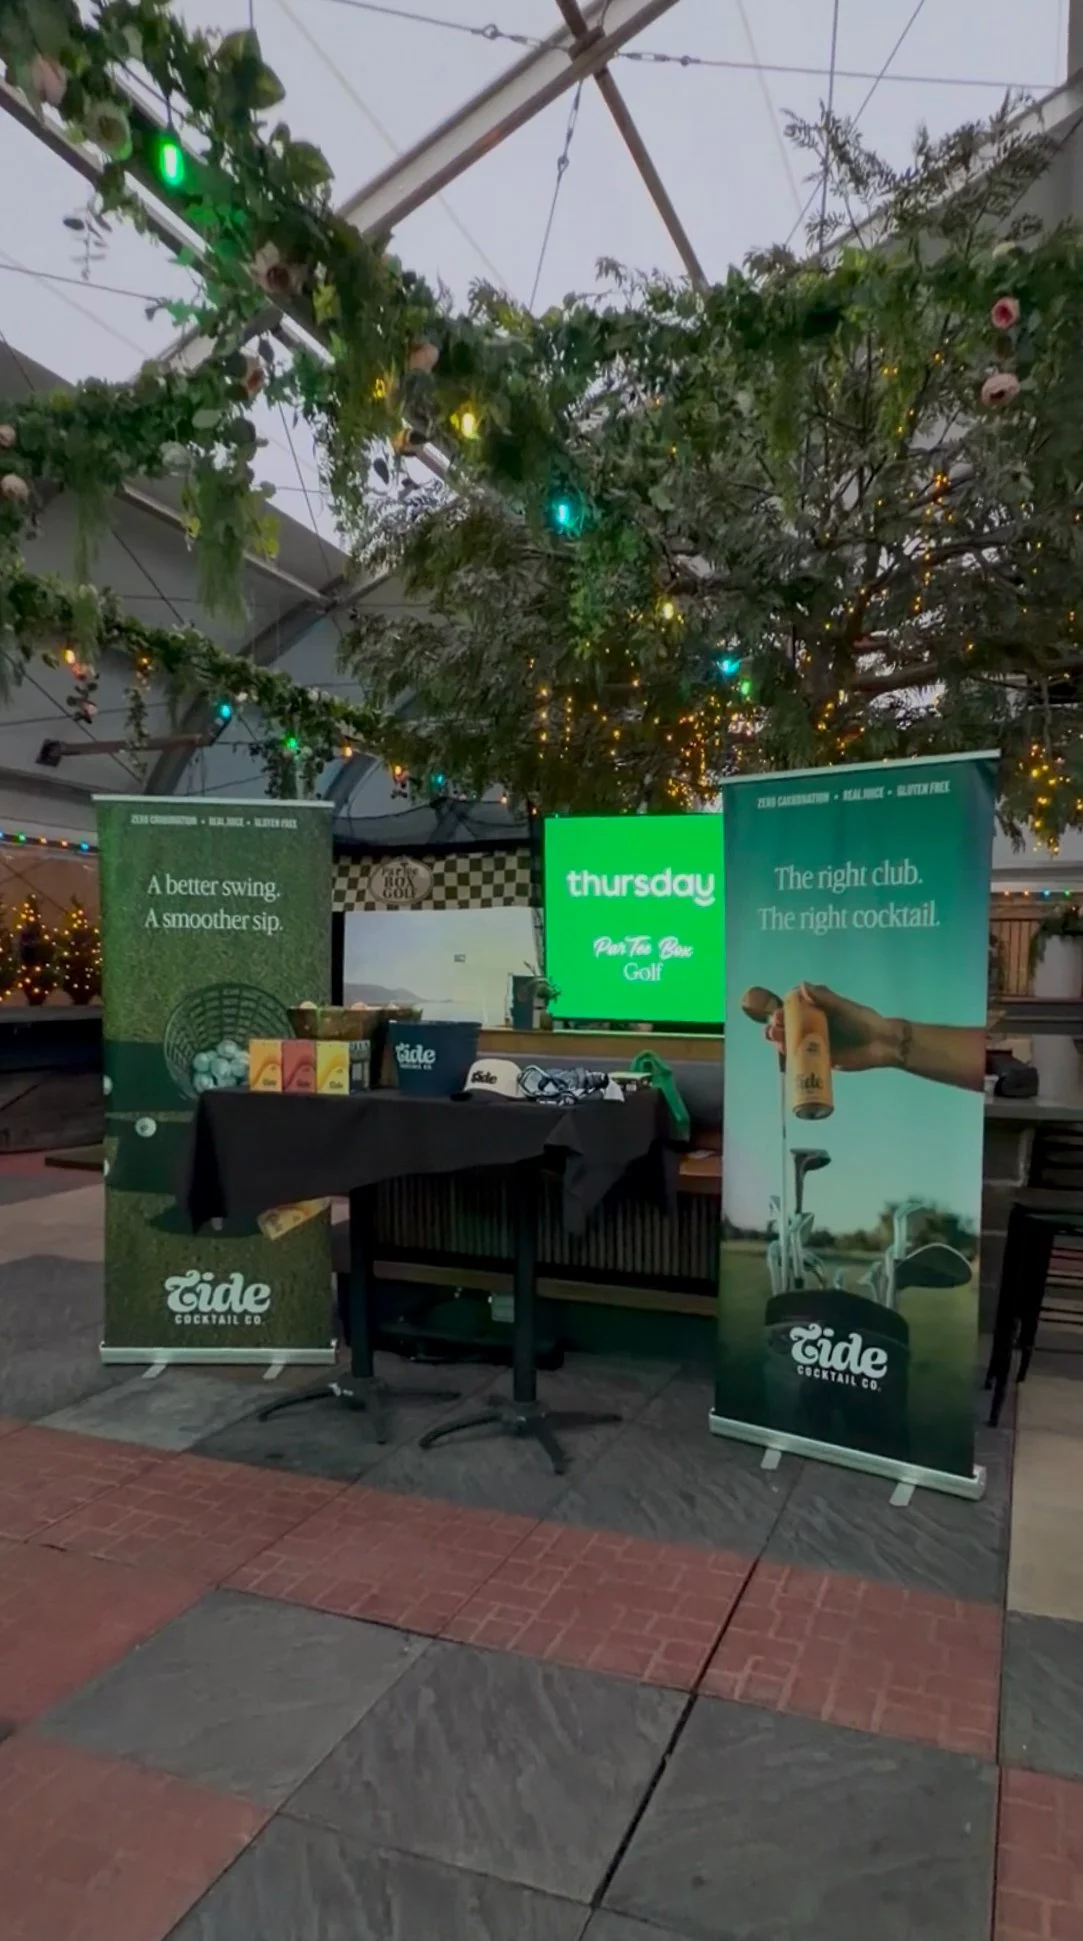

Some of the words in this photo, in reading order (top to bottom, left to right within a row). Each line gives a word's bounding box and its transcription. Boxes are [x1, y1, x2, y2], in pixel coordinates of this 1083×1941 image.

[148, 876, 161, 895] A
[166, 873, 219, 896] better
[222, 878, 280, 902] swing.
[384, 876, 416, 888] BOX
[566, 867, 716, 907] thursday
[774, 866, 814, 890] The
[818, 861, 868, 894] right
[872, 858, 923, 887] club.
[383, 888, 416, 898] GOLF
[145, 908, 159, 928] A
[162, 908, 250, 930] smoother
[252, 911, 284, 935] sip.
[758, 906, 796, 930] The
[800, 902, 847, 936] right
[852, 900, 940, 929] cocktail.
[623, 962, 664, 982] Golf
[164, 1269, 271, 1314] Tide
[174, 1314, 240, 1326] COCKTAIL
[789, 1322, 888, 1379] Tide
[797, 1365, 858, 1387] COCKTAIL
[862, 1379, 882, 1392] CO.
